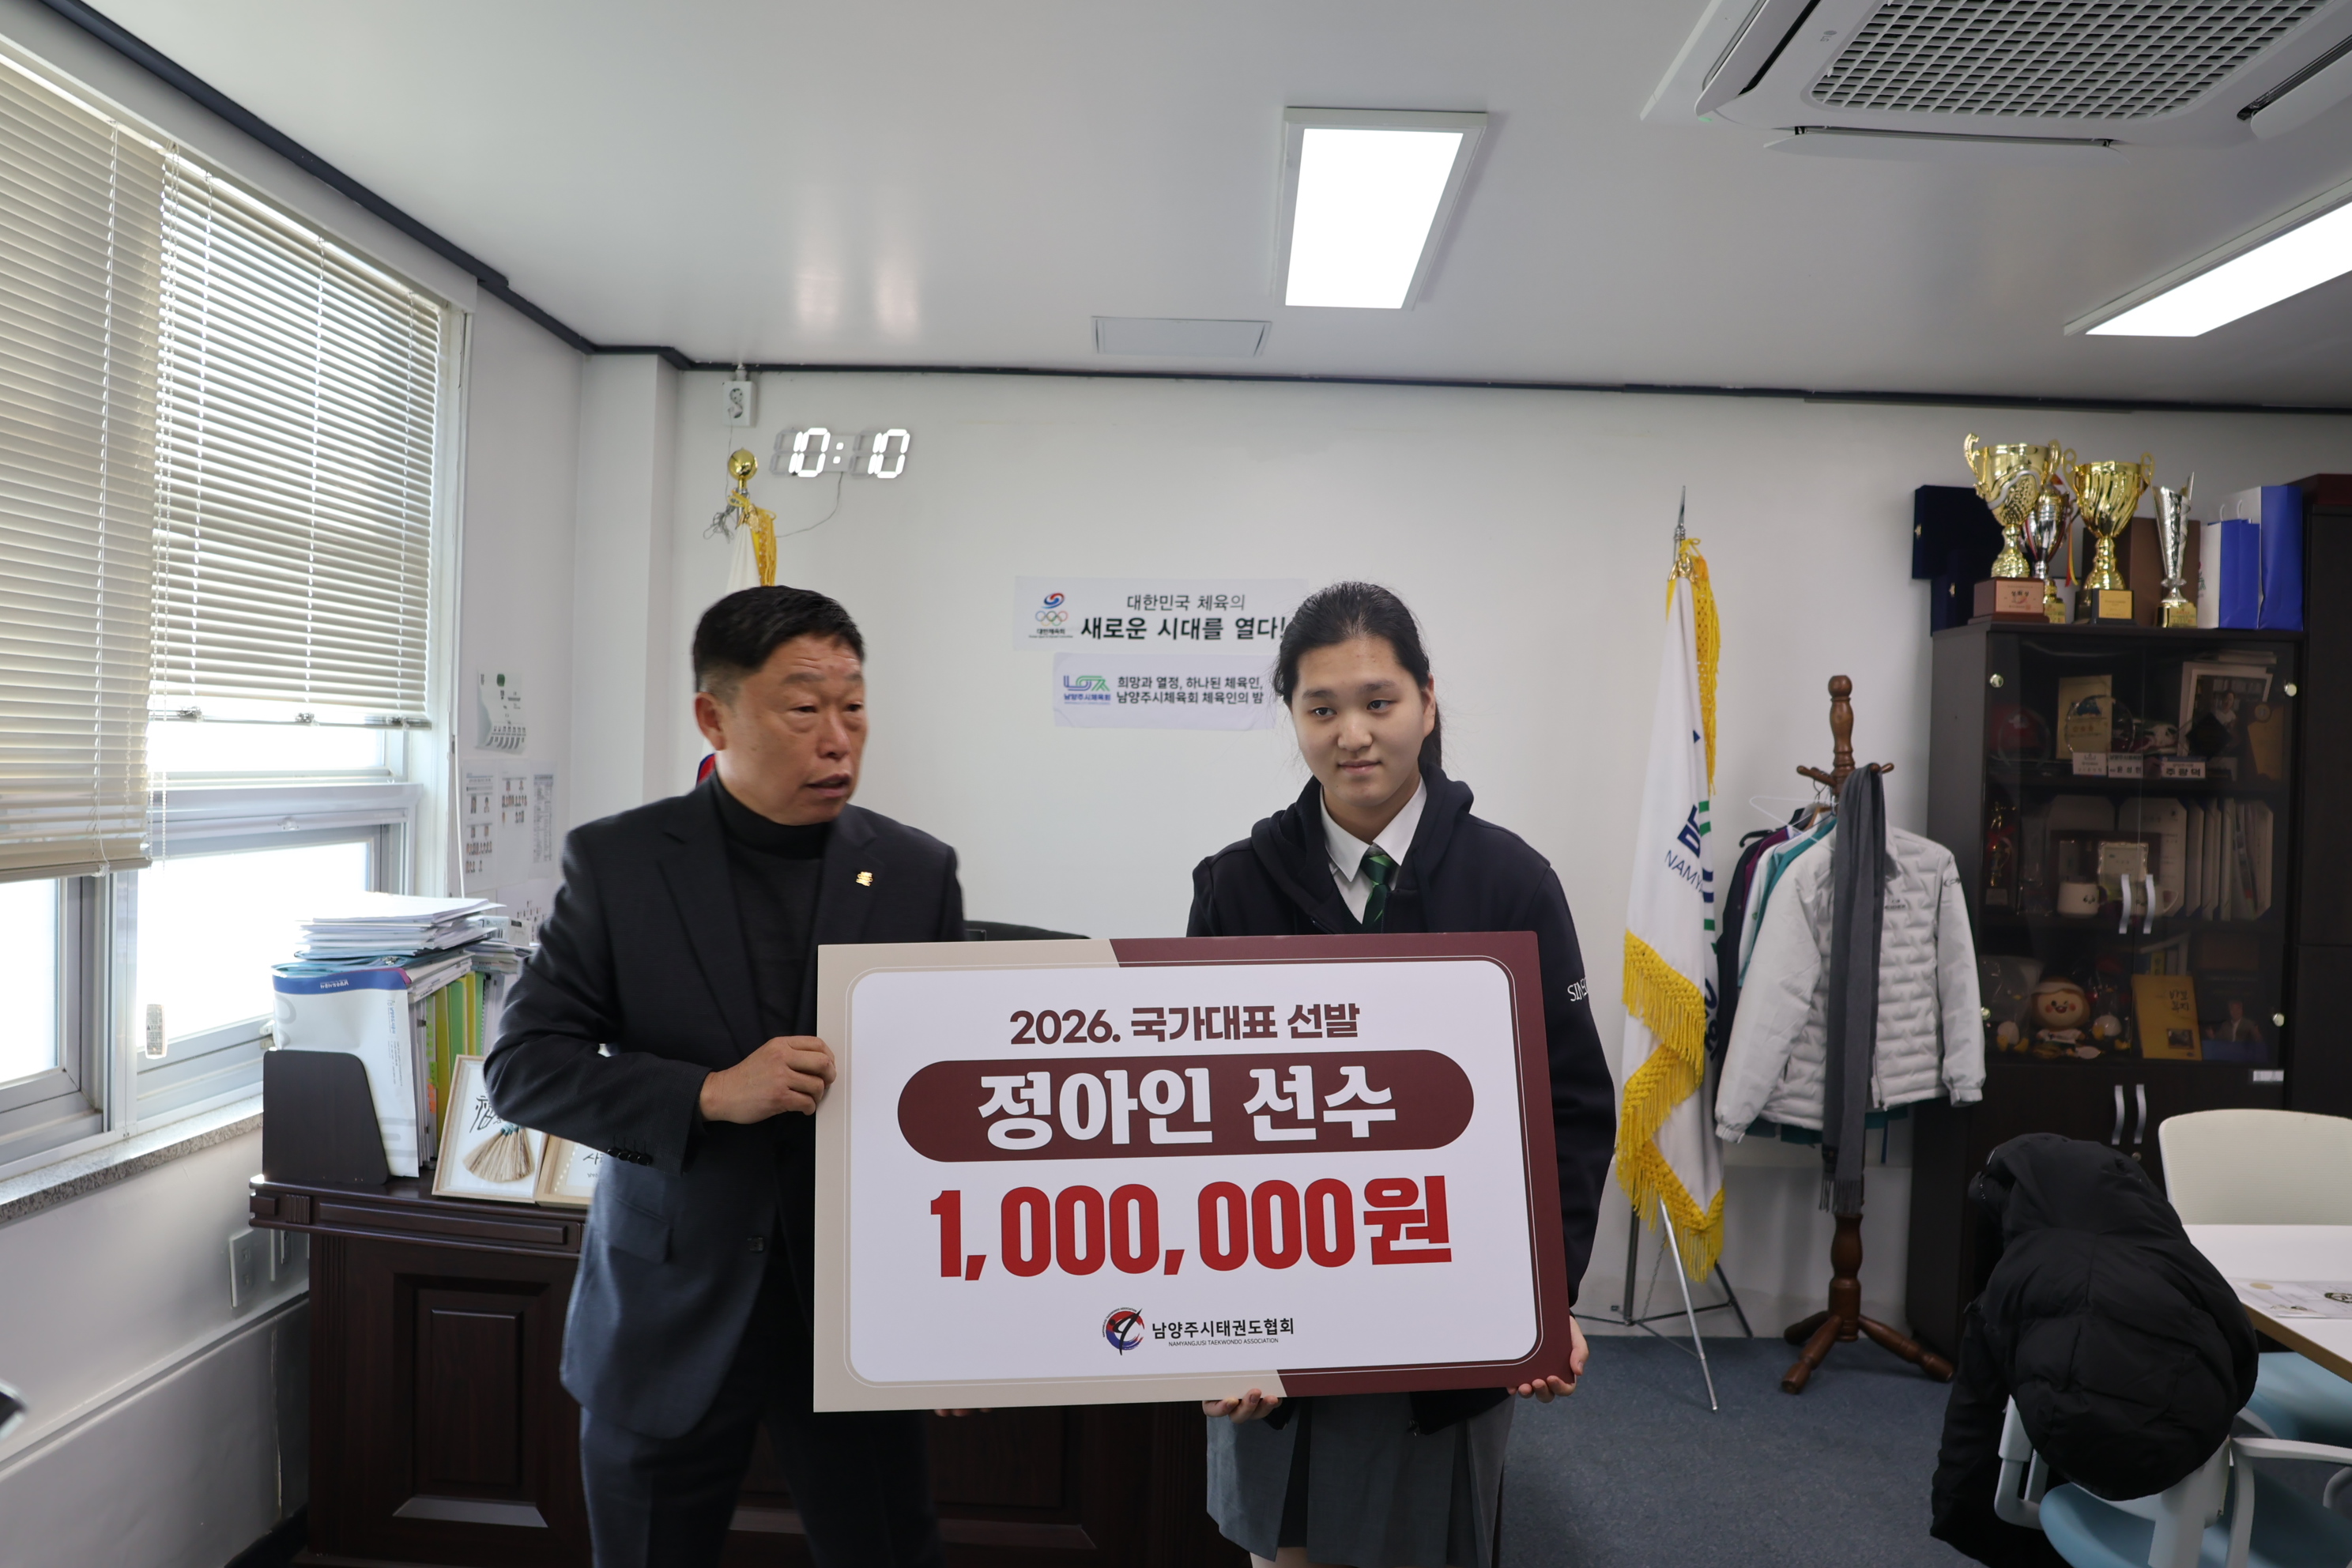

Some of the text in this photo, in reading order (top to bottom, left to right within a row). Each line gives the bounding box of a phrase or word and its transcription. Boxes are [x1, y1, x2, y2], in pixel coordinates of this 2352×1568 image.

[789, 428, 910, 478] 10:10
[1127, 594, 1246, 611] 대한민국 체육의
[1080, 616, 1286, 640] 새로운 시대를 열다!
[1118, 677, 1264, 690] 희망과 열정, 하나된 체육인,
[1116, 692, 1264, 704] 남양주시체육회 체육인의 밤
[1009, 1002, 1360, 1045] 2026. 국가대표 선발
[977, 1065, 1396, 1150] 정아인 선수
[1152, 1317, 1294, 1340] 남양주시태권도협회
